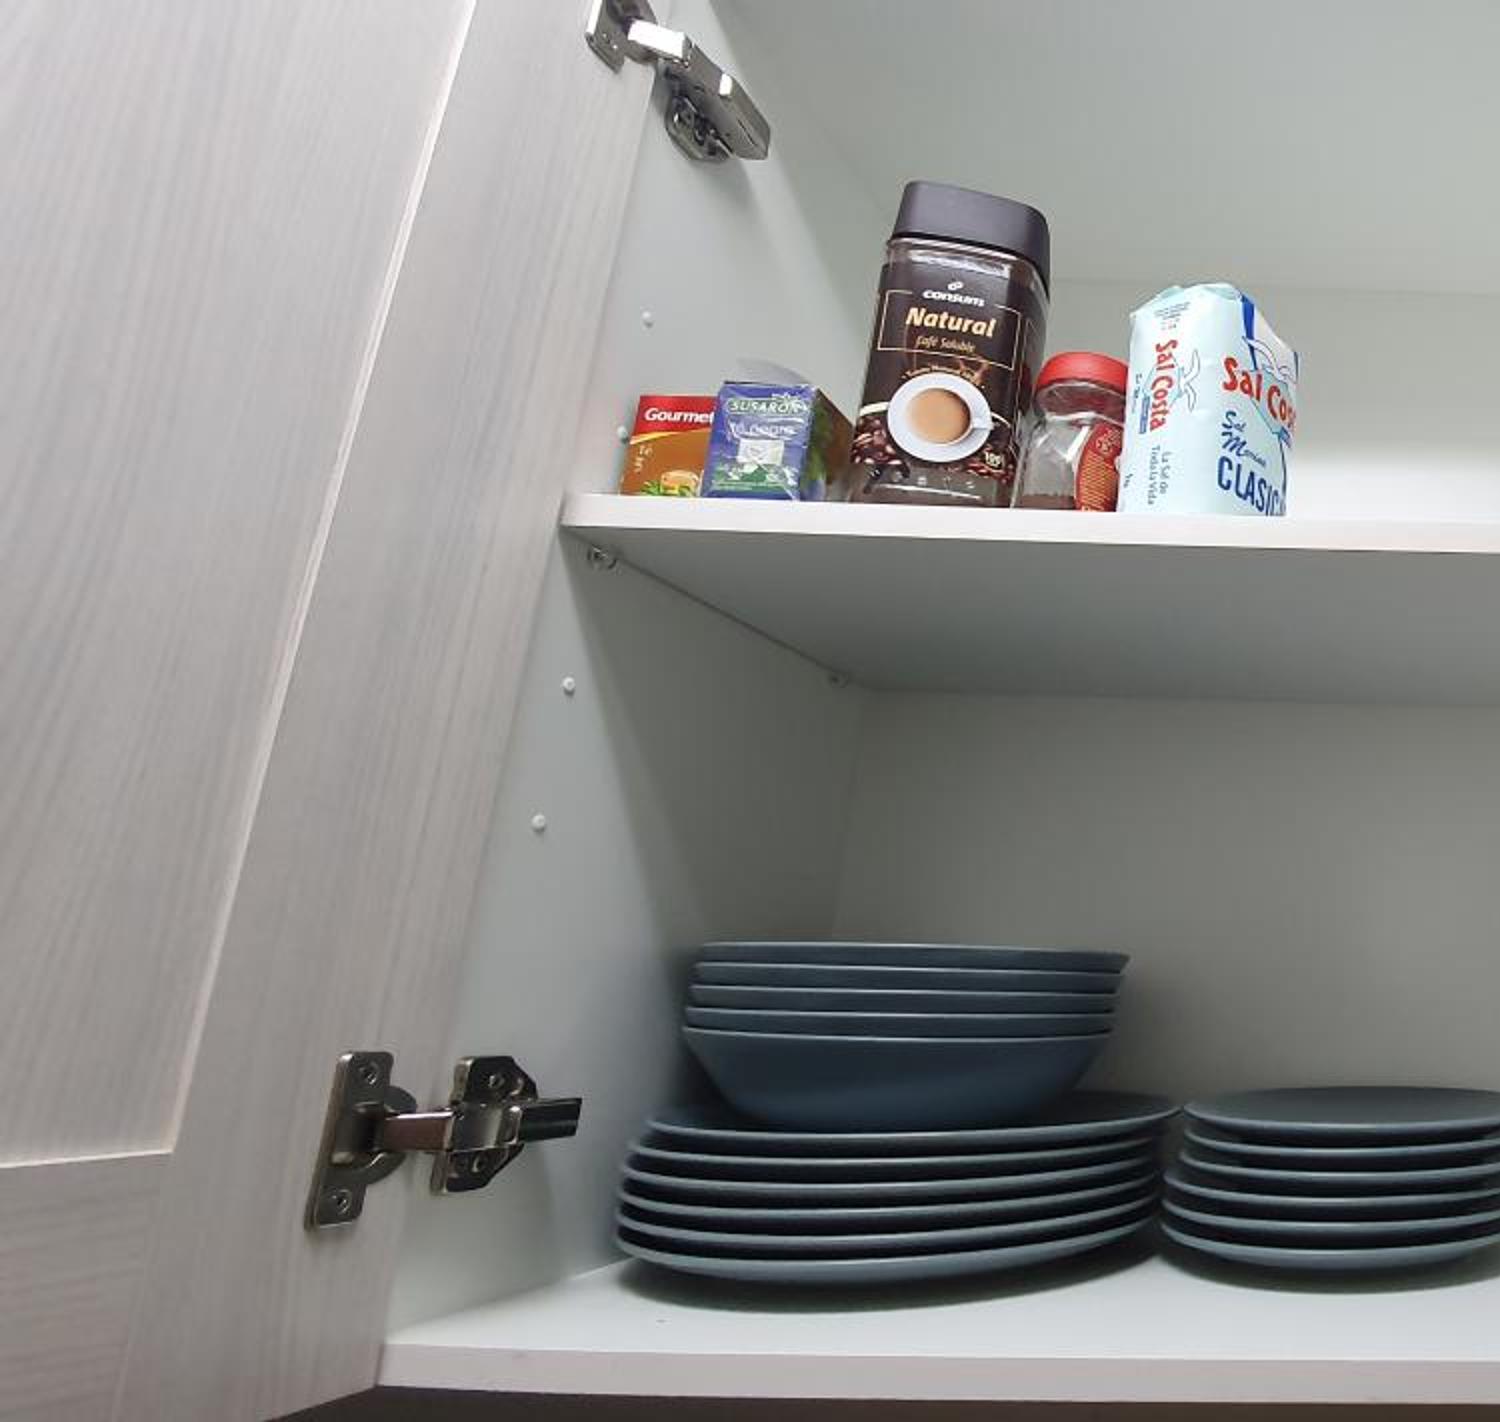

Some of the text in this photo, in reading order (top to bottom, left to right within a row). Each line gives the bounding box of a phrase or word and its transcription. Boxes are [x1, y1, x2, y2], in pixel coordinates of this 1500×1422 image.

[905, 307, 997, 338] Natural
[1155, 339, 1178, 371] Sal
[1221, 357, 1263, 402] Sal
[1150, 376, 1174, 432] Costa
